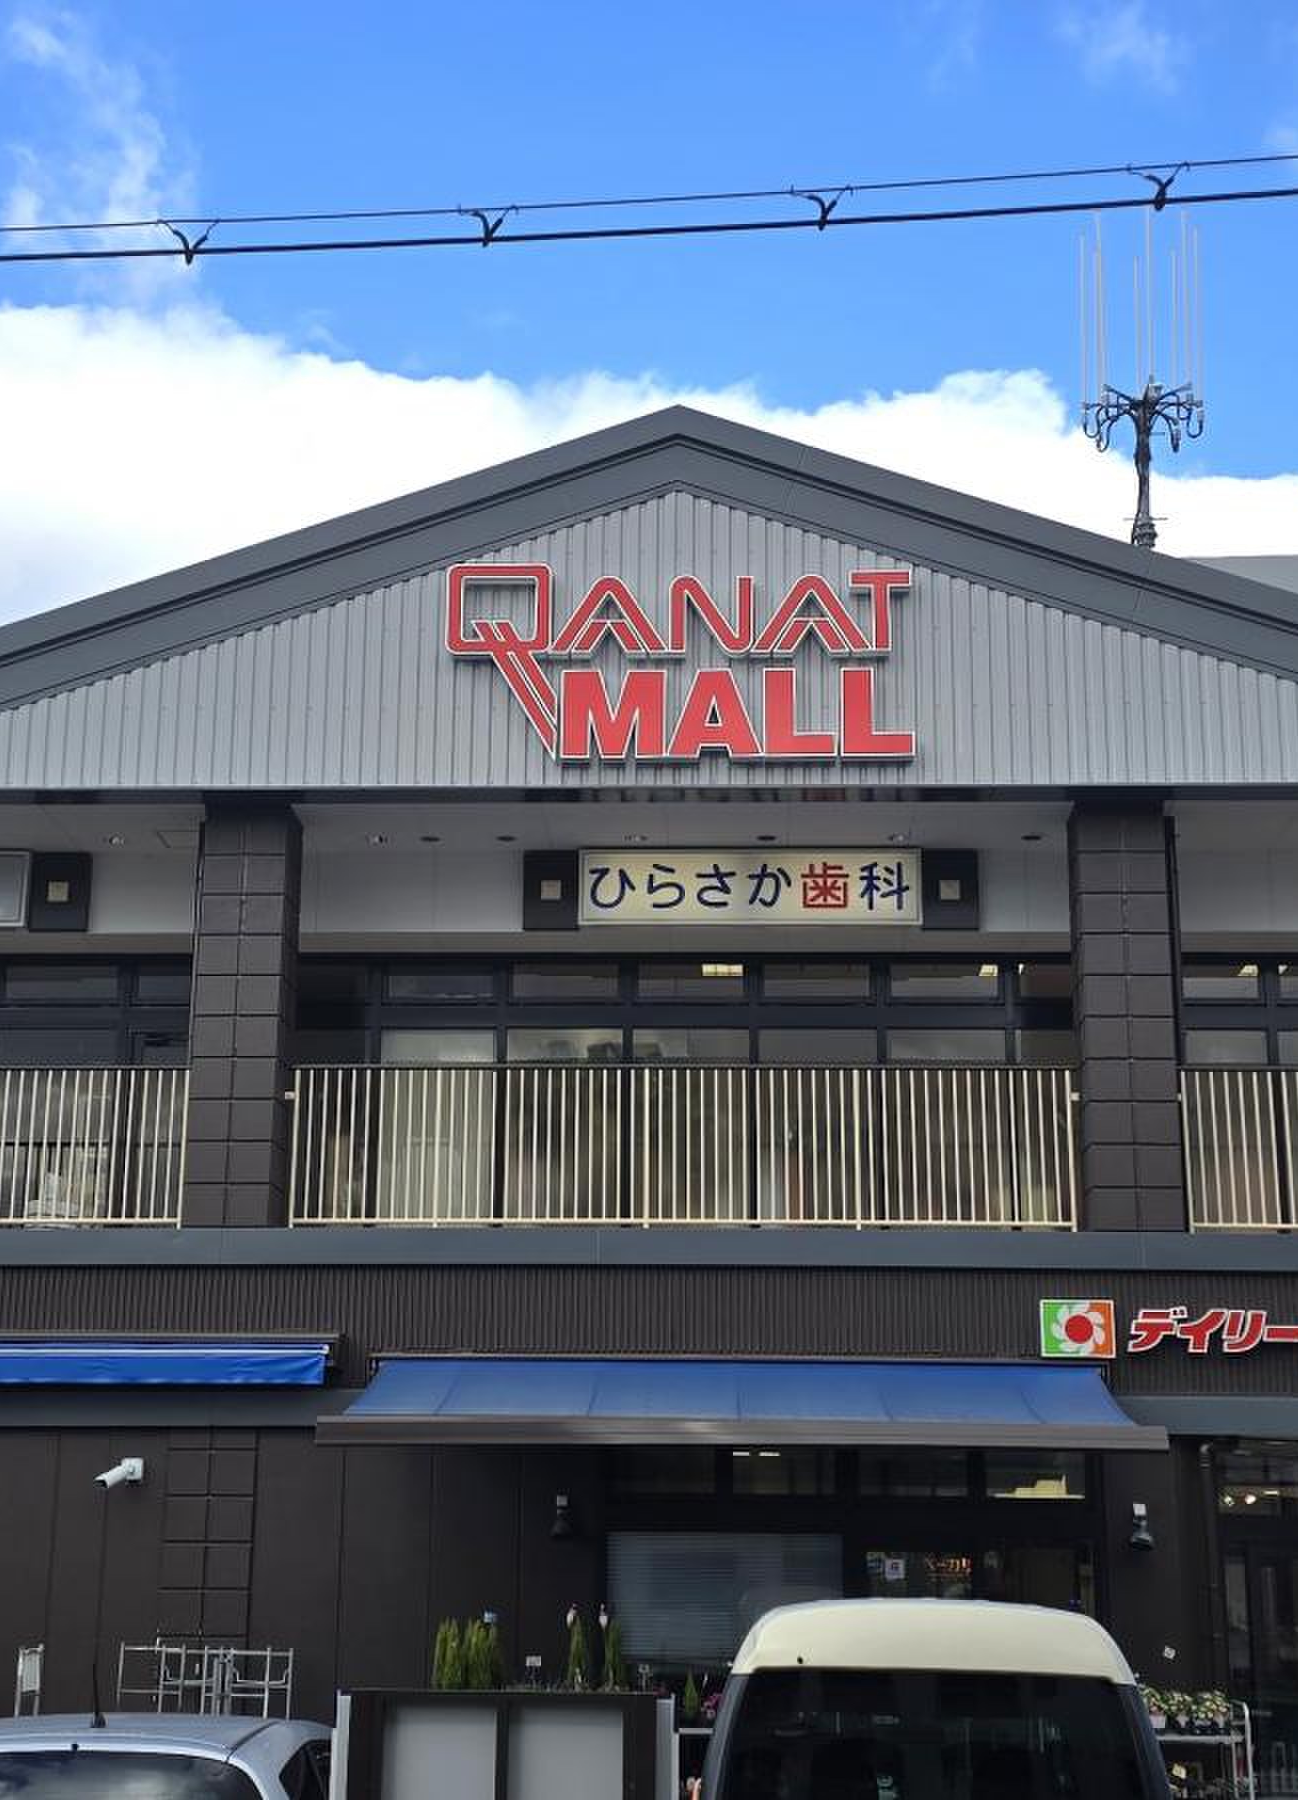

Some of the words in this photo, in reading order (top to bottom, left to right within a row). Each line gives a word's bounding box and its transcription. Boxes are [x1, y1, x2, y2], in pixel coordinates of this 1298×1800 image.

[445, 563, 912, 760] QANAT
[558, 667, 916, 764] MALL
[588, 860, 911, 911] ひらさか歯科
